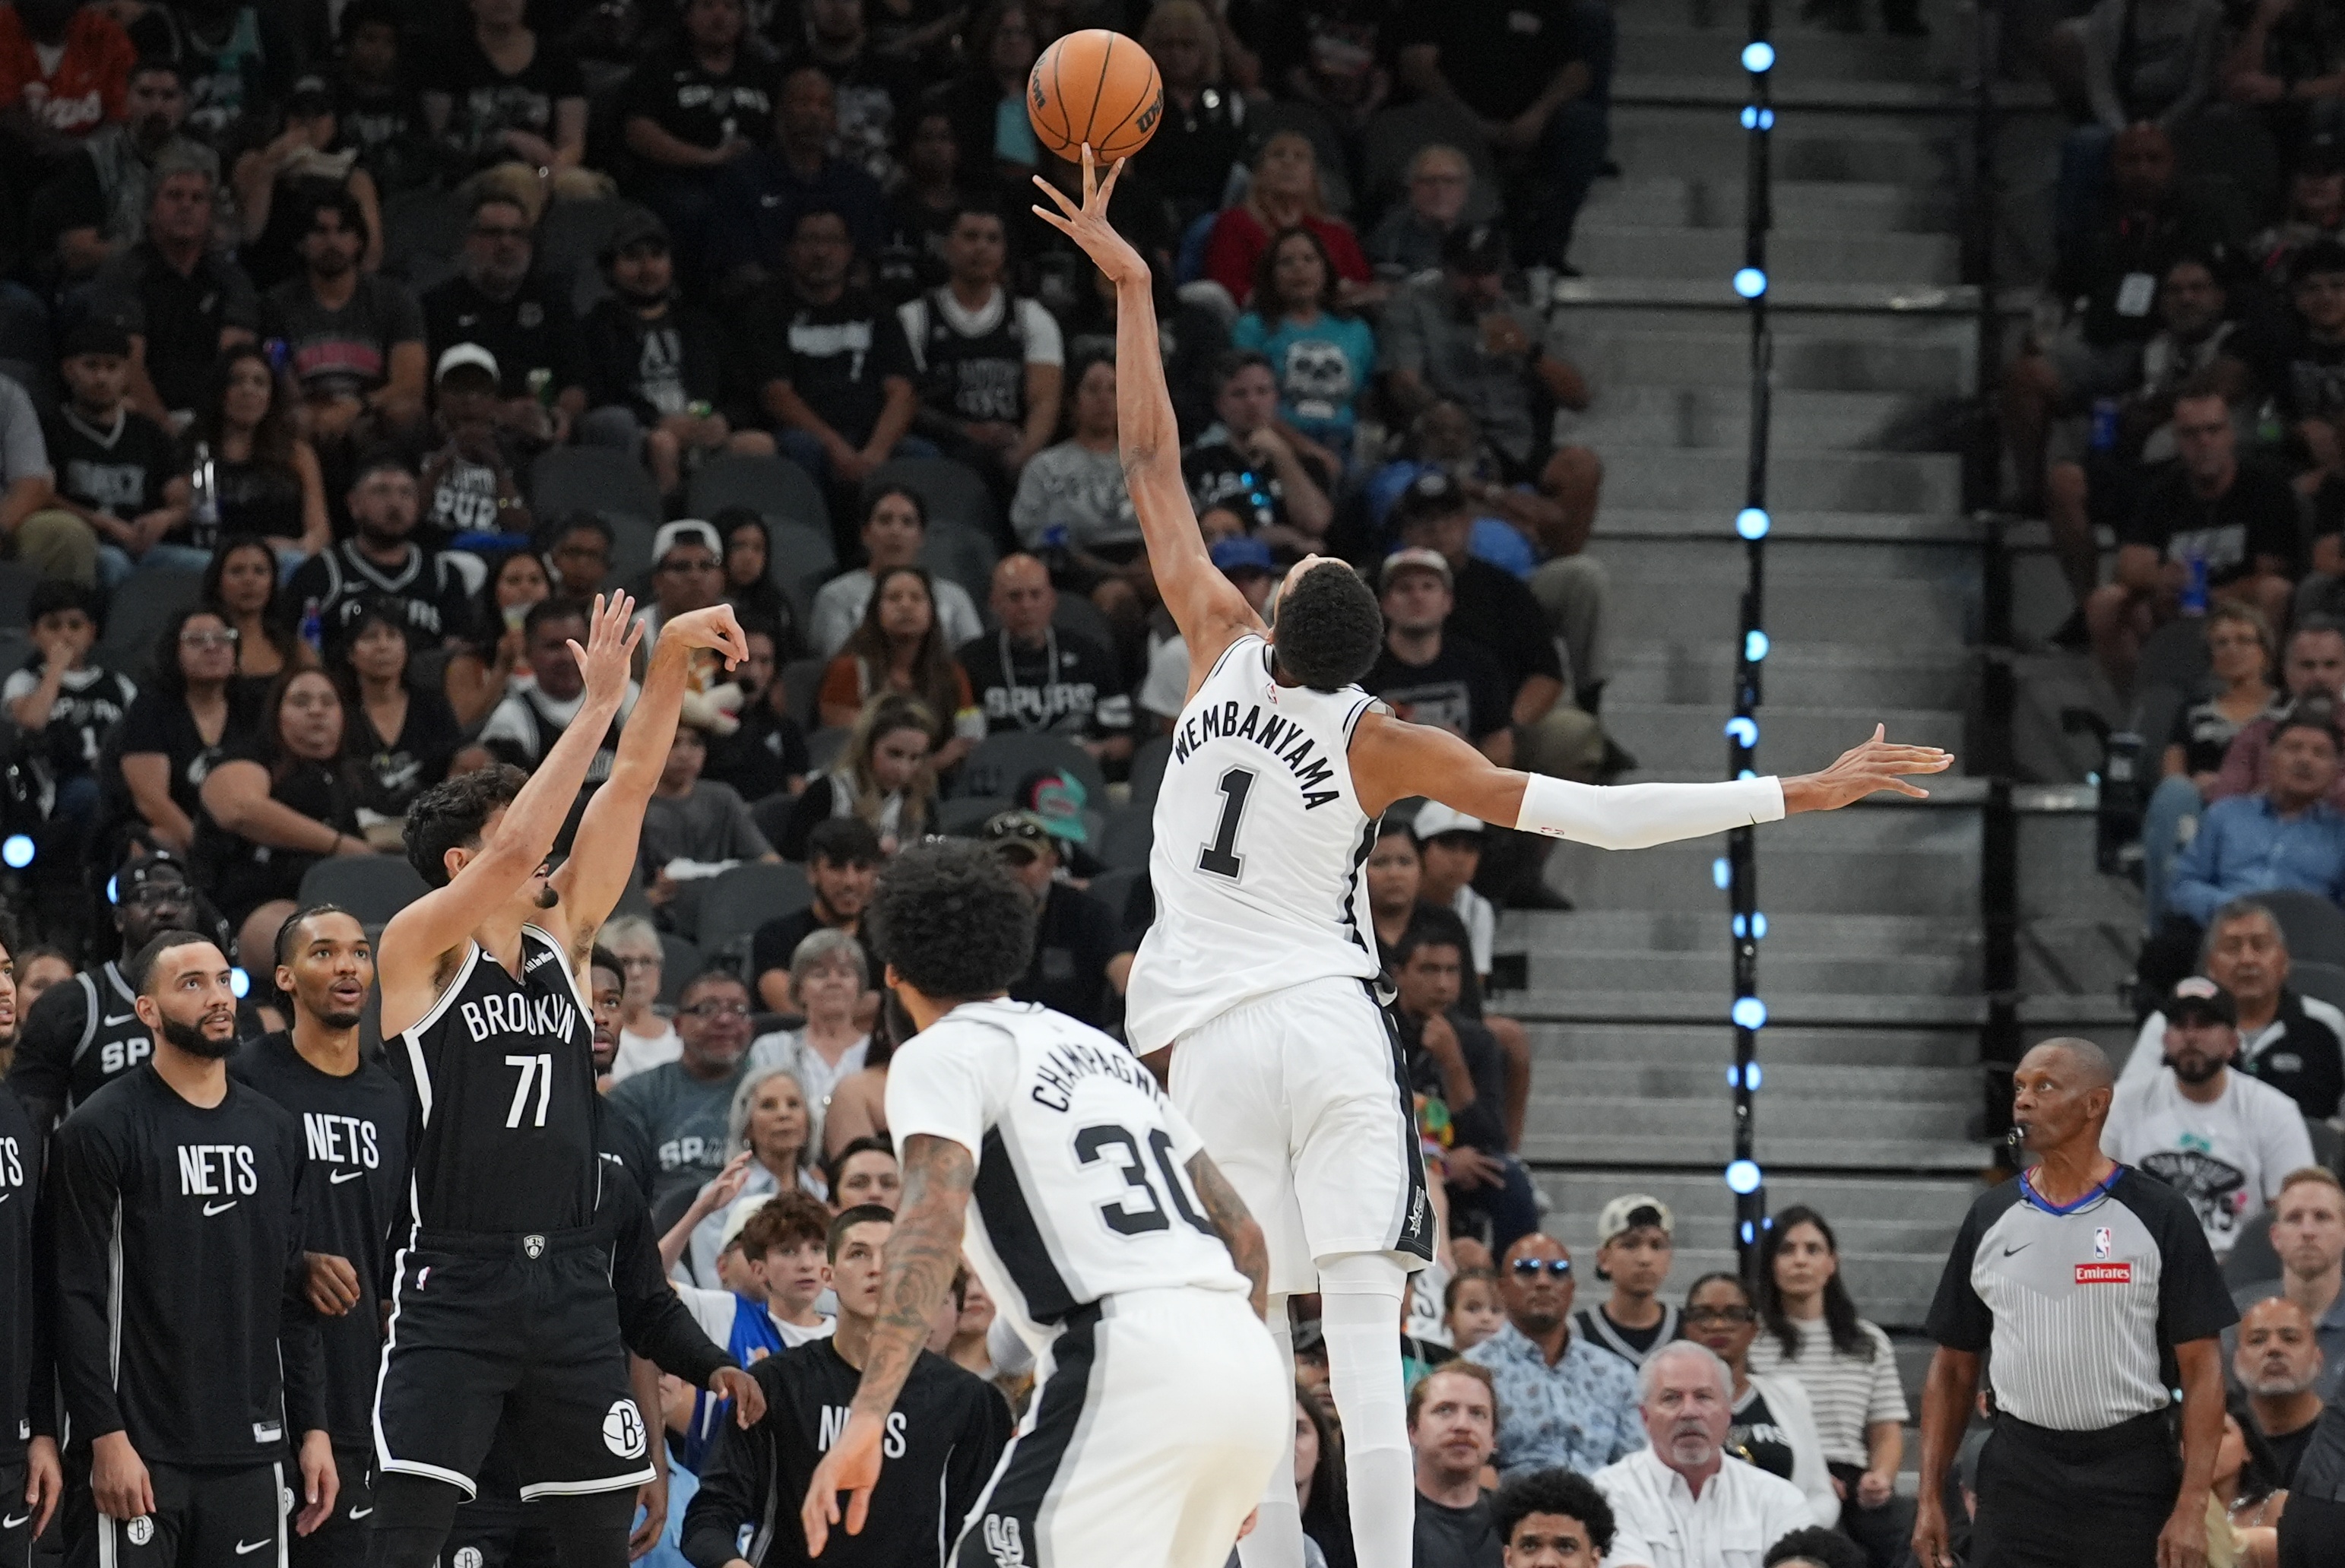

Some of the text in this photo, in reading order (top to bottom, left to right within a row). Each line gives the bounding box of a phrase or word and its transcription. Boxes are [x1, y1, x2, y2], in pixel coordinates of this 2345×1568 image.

[1175, 701, 1340, 811] WEMBANYAMA
[1196, 765, 1258, 882] 1
[505, 1053, 552, 1128] 71
[304, 1113, 379, 1170] NETS
[177, 1145, 258, 1196] NETS
[526, 1237, 543, 1247] NETS
[2076, 1265, 2130, 1280] Emirates
[620, 1408, 638, 1451] B
[818, 1404, 908, 1459] NS
[136, 1519, 145, 1541] B
